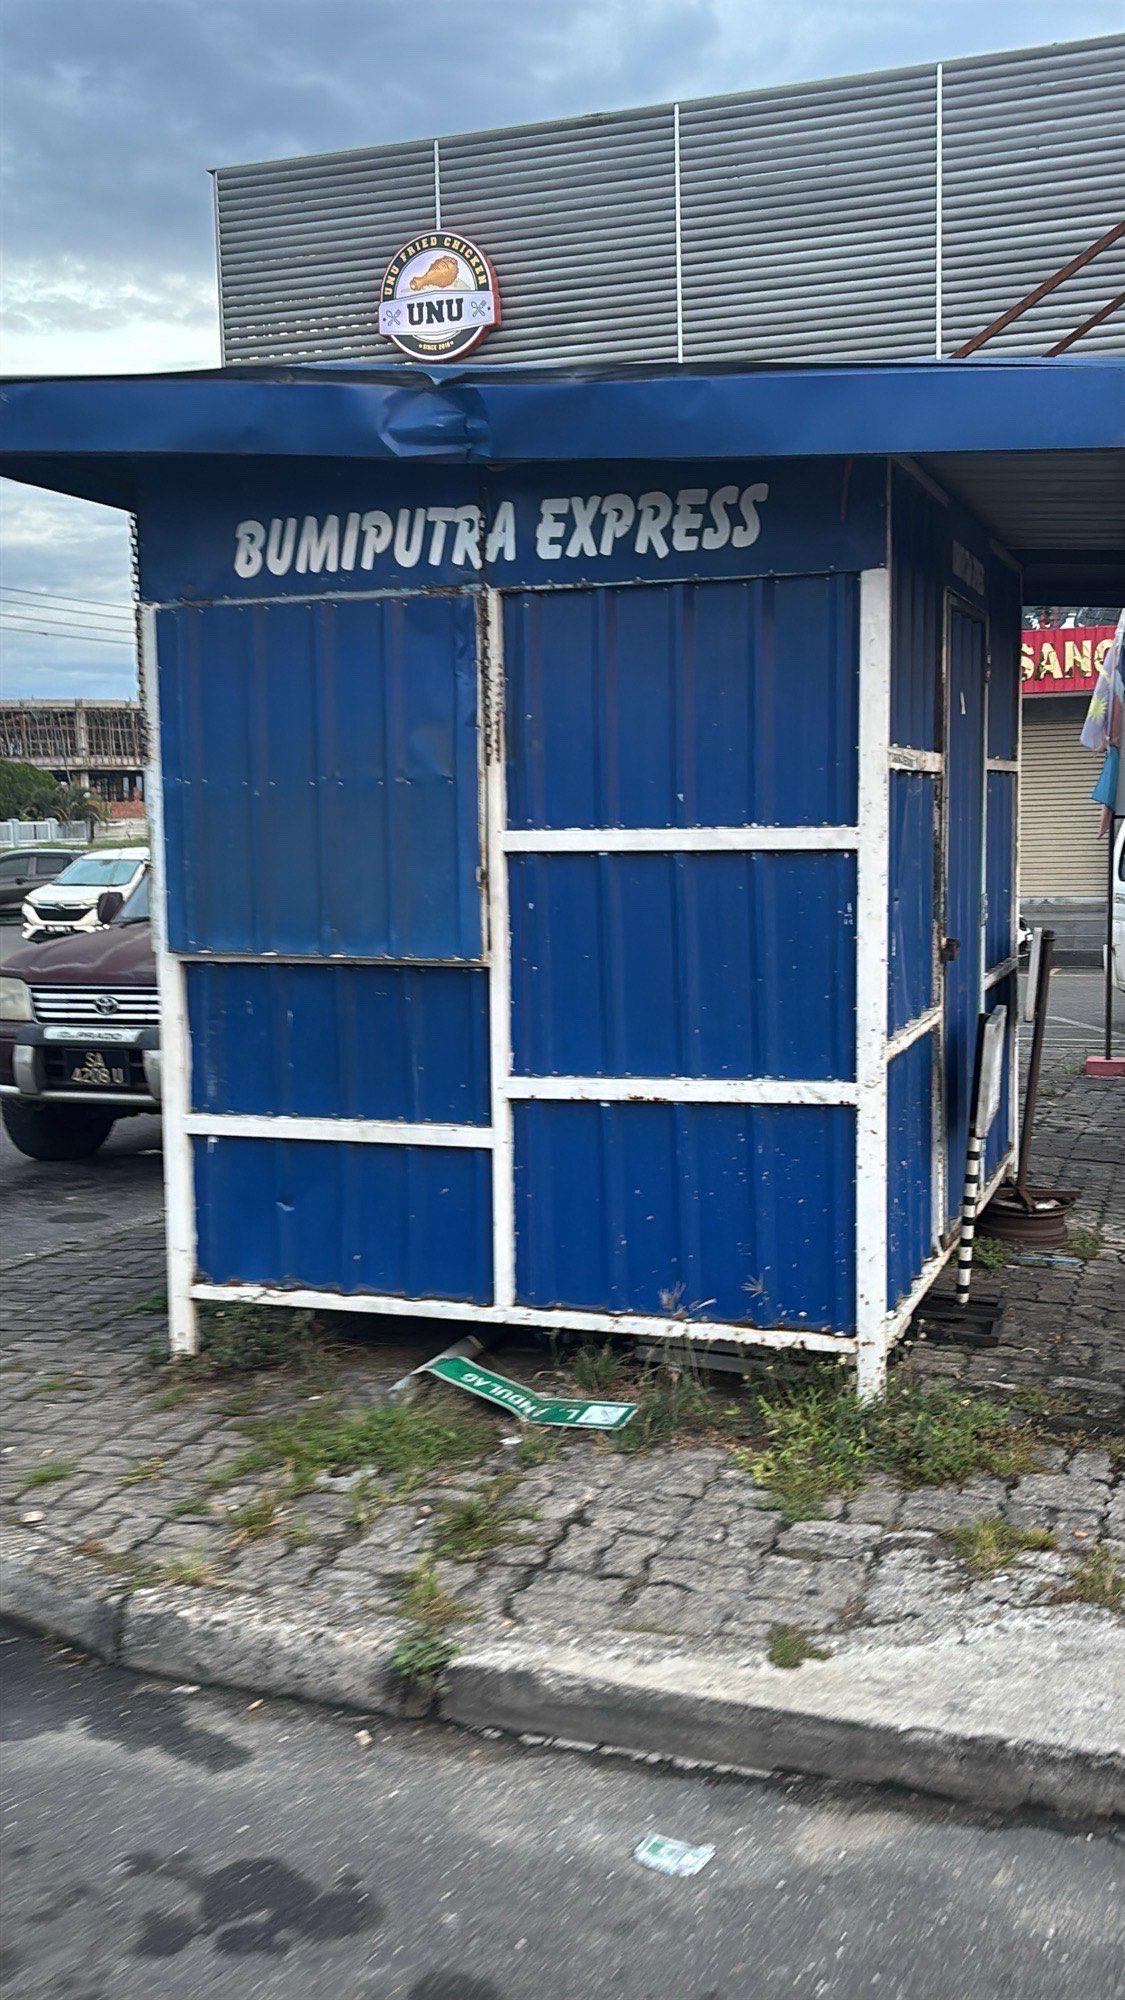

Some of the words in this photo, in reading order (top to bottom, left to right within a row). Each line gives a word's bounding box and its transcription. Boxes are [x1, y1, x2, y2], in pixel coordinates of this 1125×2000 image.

[400, 236, 437, 262] FRIED
[443, 237, 488, 285] CHICKEN
[406, 298, 464, 326] UNU
[234, 501, 516, 578] BUMIPUTRA
[536, 483, 770, 560] EXPRESS
